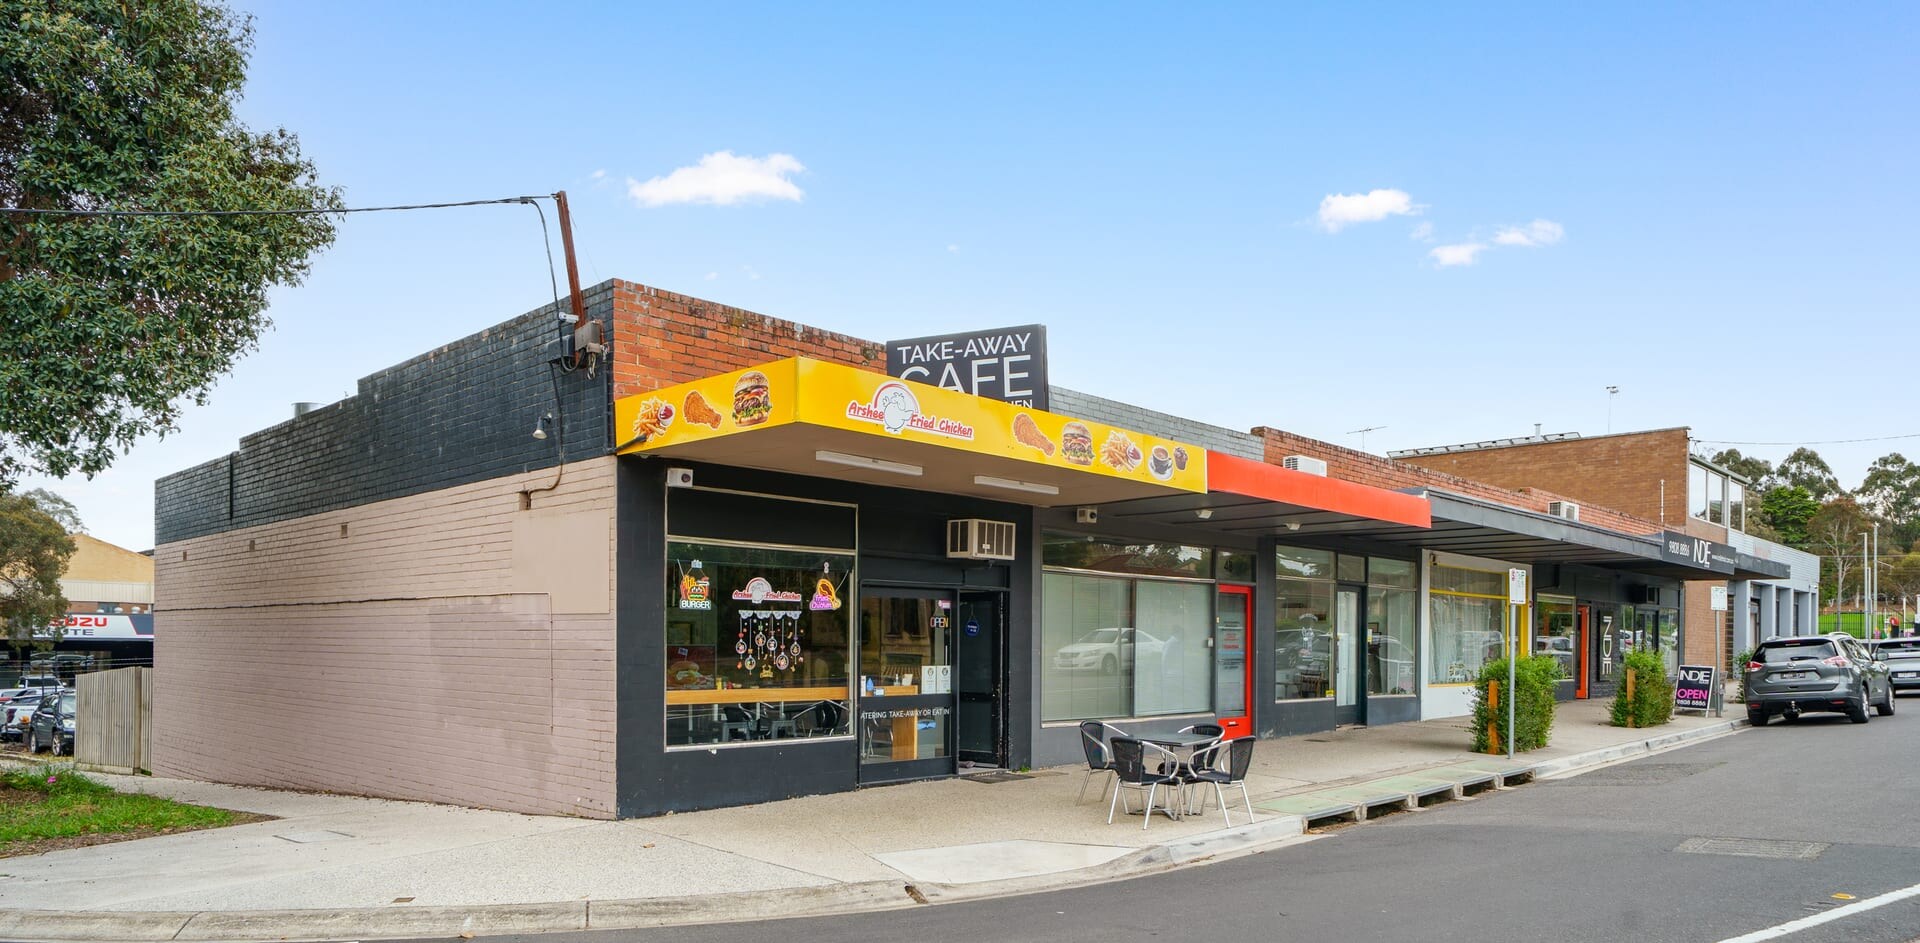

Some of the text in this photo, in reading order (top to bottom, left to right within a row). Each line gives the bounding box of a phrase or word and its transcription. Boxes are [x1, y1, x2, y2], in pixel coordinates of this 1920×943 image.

[897, 333, 1031, 364] TAKE-AWAY
[848, 402, 973, 437] Arshee Fried Chicken
[681, 600, 711, 609] BURGER
[930, 616, 949, 628] OPEN
[1677, 688, 1708, 700] OPEN
[861, 710, 887, 720] ATERING
[889, 709, 922, 718] TAKE-AWAY
